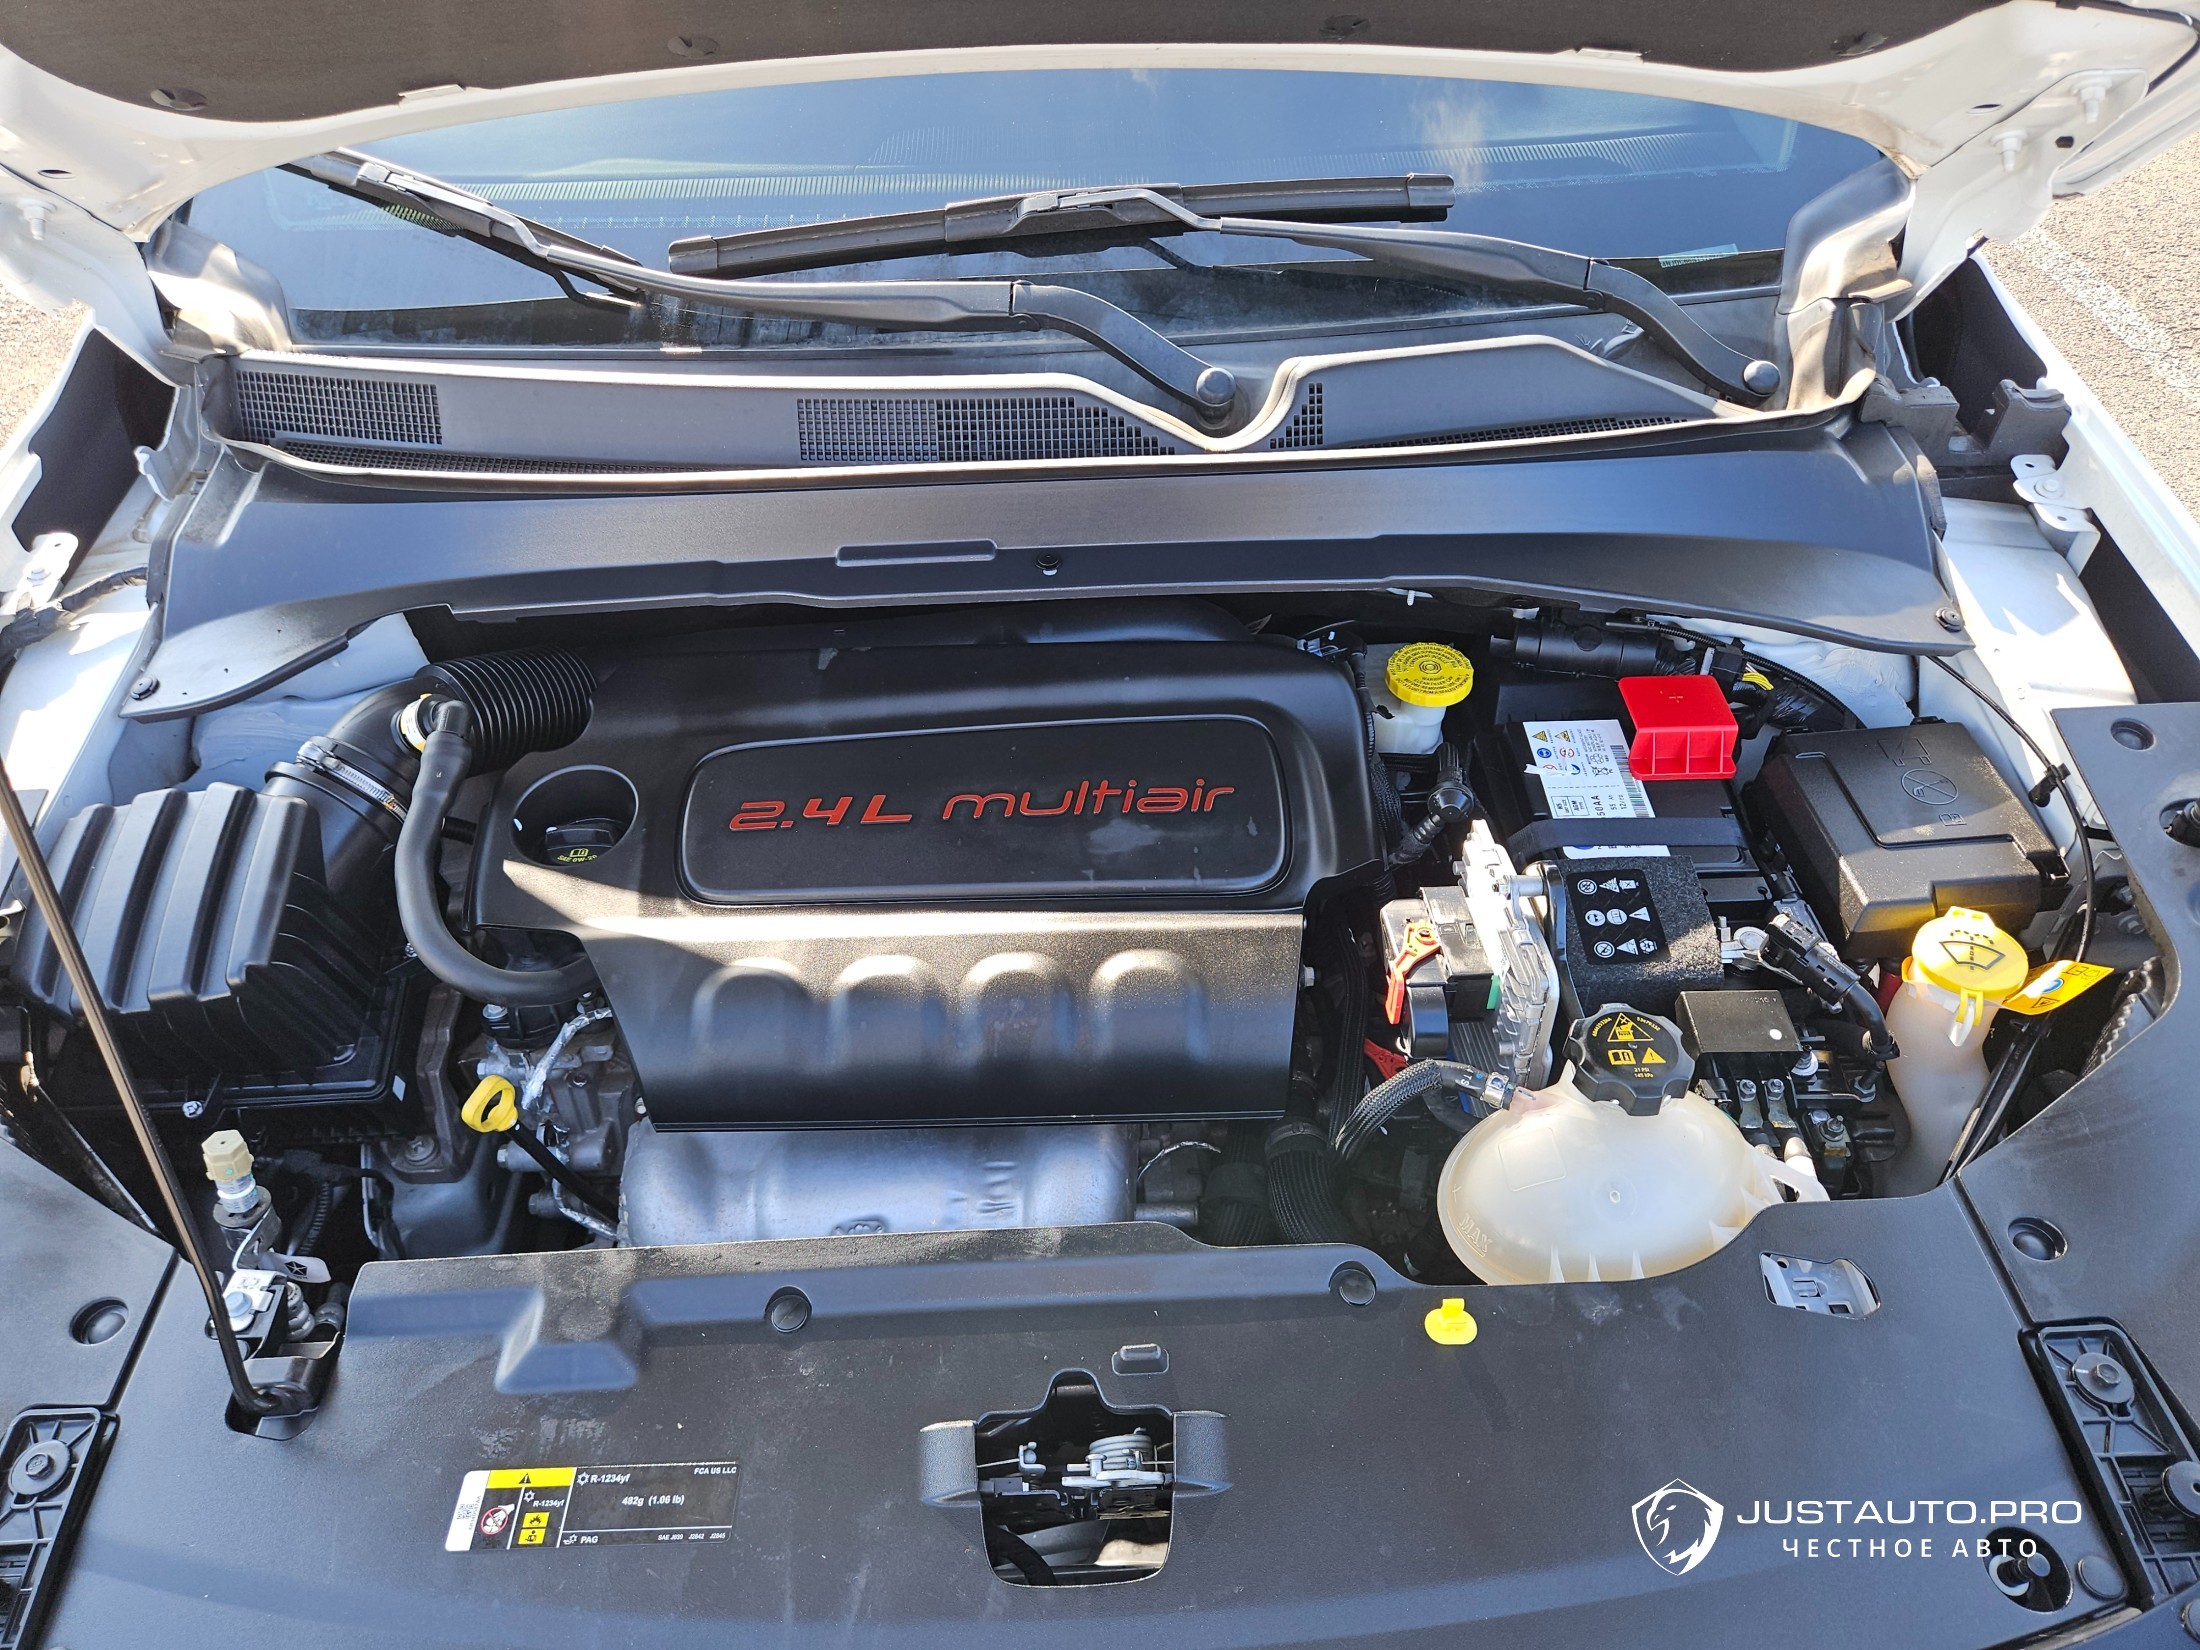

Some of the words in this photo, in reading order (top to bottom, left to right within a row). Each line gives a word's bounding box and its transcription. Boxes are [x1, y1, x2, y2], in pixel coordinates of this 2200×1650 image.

[730, 794, 914, 831] 2.4L
[941, 778, 1235, 821] multiair
[1459, 1212, 1494, 1253] MAX
[694, 1467, 710, 1475] FCA
[710, 1466, 721, 1475] US
[722, 1466, 738, 1474] LLC
[590, 1473, 630, 1484] R-1234yf
[533, 1499, 565, 1508] R-1234yf
[622, 1496, 644, 1506] 482g
[648, 1495, 671, 1506] (1.06
[672, 1494, 685, 1505] lb)
[580, 1535, 599, 1544] PAG
